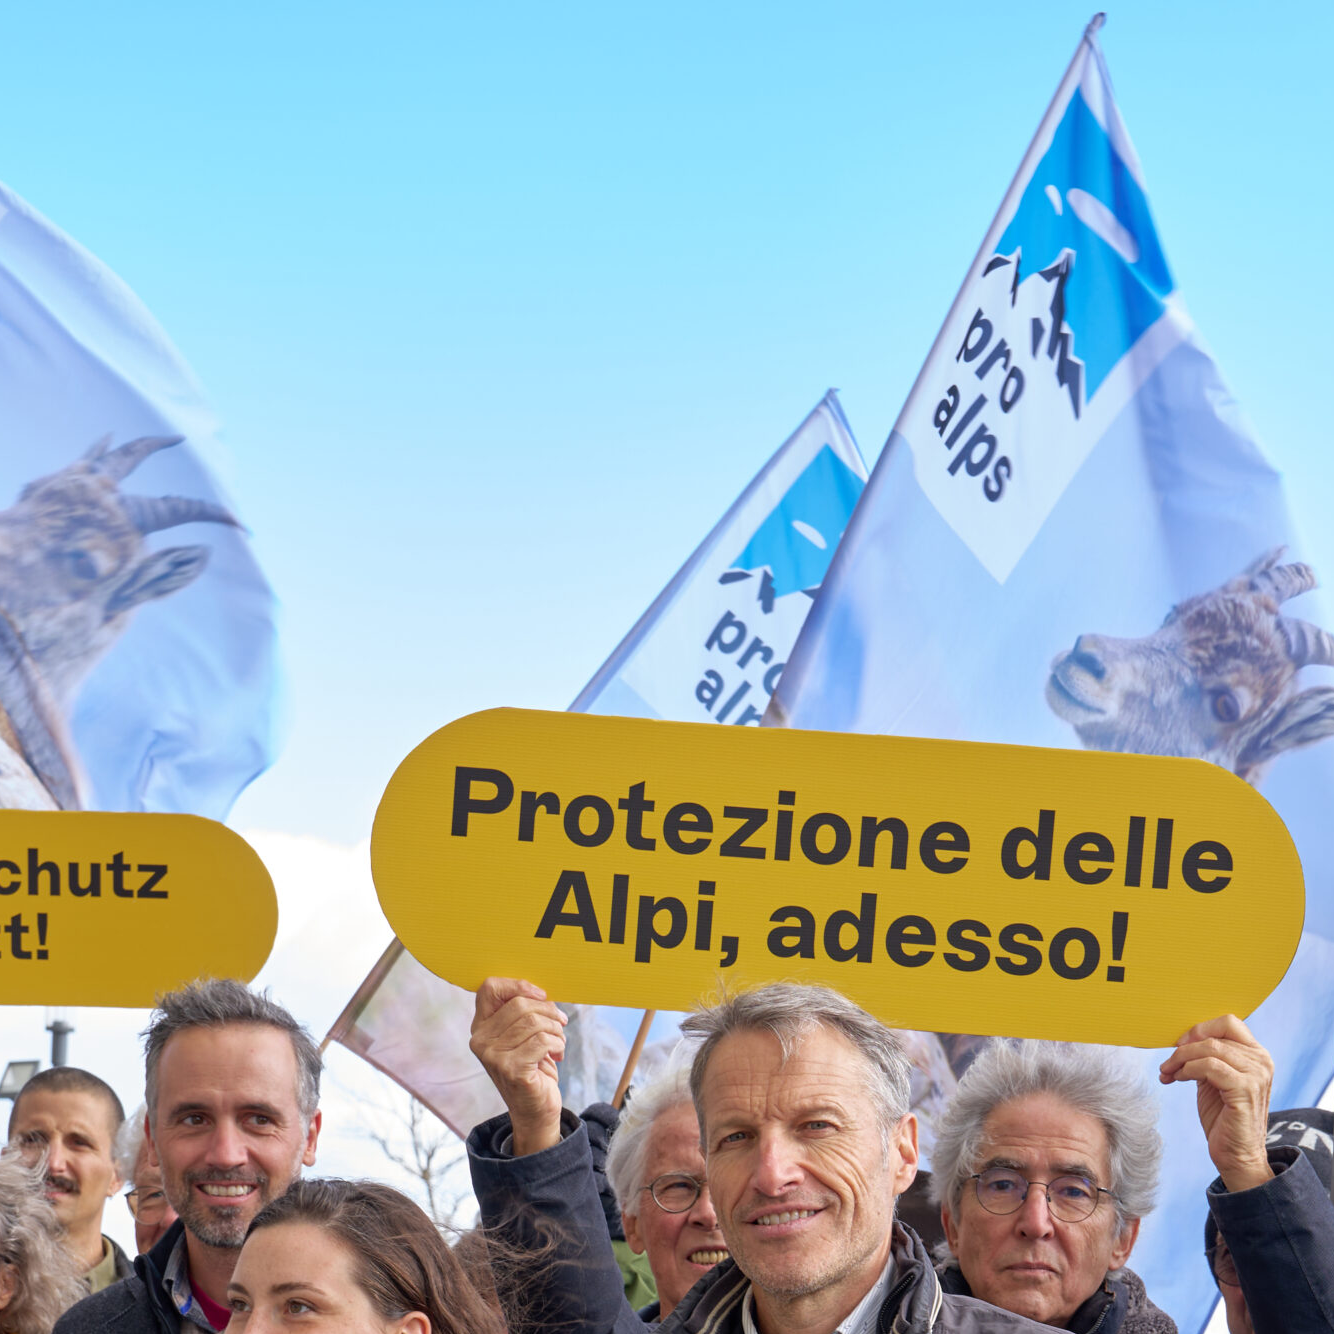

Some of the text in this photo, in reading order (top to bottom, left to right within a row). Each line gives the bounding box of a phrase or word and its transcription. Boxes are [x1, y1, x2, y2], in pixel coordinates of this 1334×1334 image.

[955, 307, 1025, 414] pro
[933, 384, 1012, 502] alps
[450, 766, 1234, 894] Protezione delle
[534, 870, 1130, 983] Alpi, adesso!
